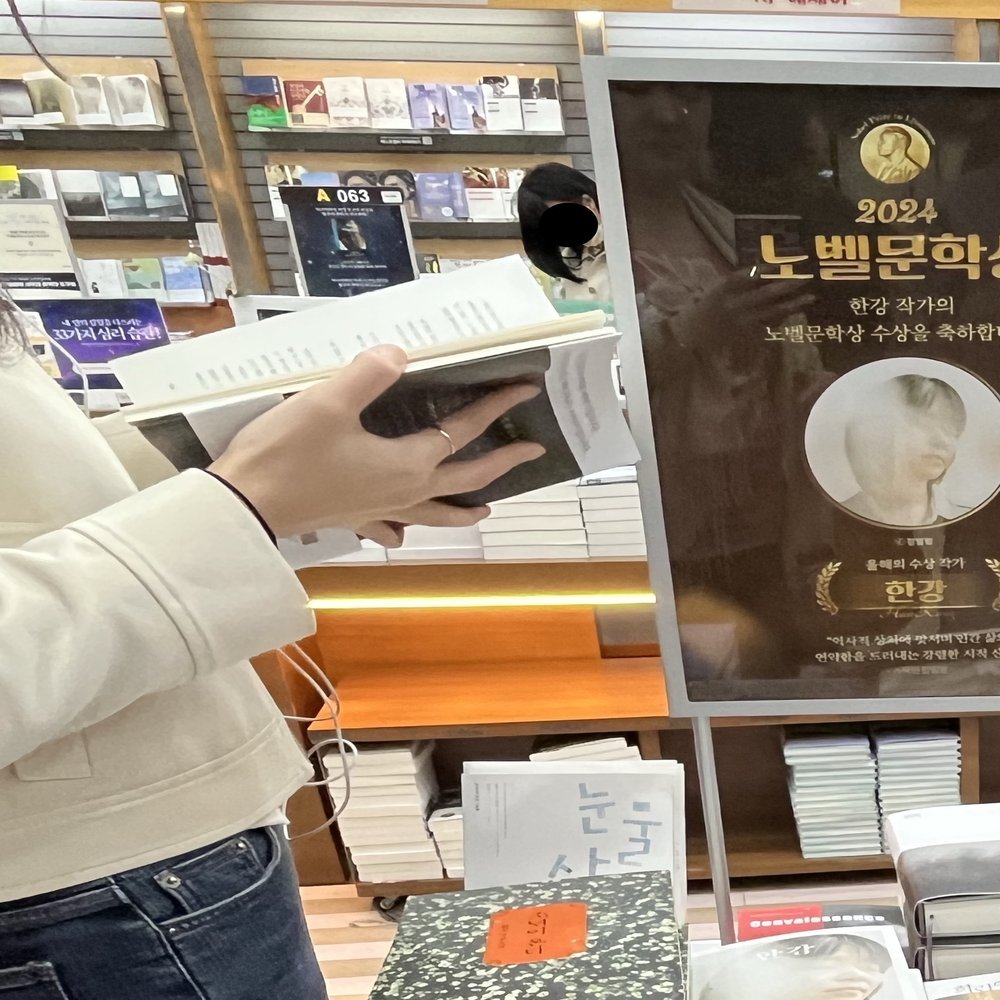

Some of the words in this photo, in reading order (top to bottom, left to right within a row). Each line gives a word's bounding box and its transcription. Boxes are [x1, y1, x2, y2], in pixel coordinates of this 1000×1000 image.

[316, 188, 331, 202] A
[336, 188, 371, 203] 063
[855, 198, 938, 224] 2024
[849, 297, 889, 316] 한강
[896, 296, 954, 316] 작가의
[764, 323, 866, 343] 노벨문학상
[870, 323, 931, 343] 수상을
[909, 557, 936, 570] 수상
[885, 579, 948, 604] 한강
